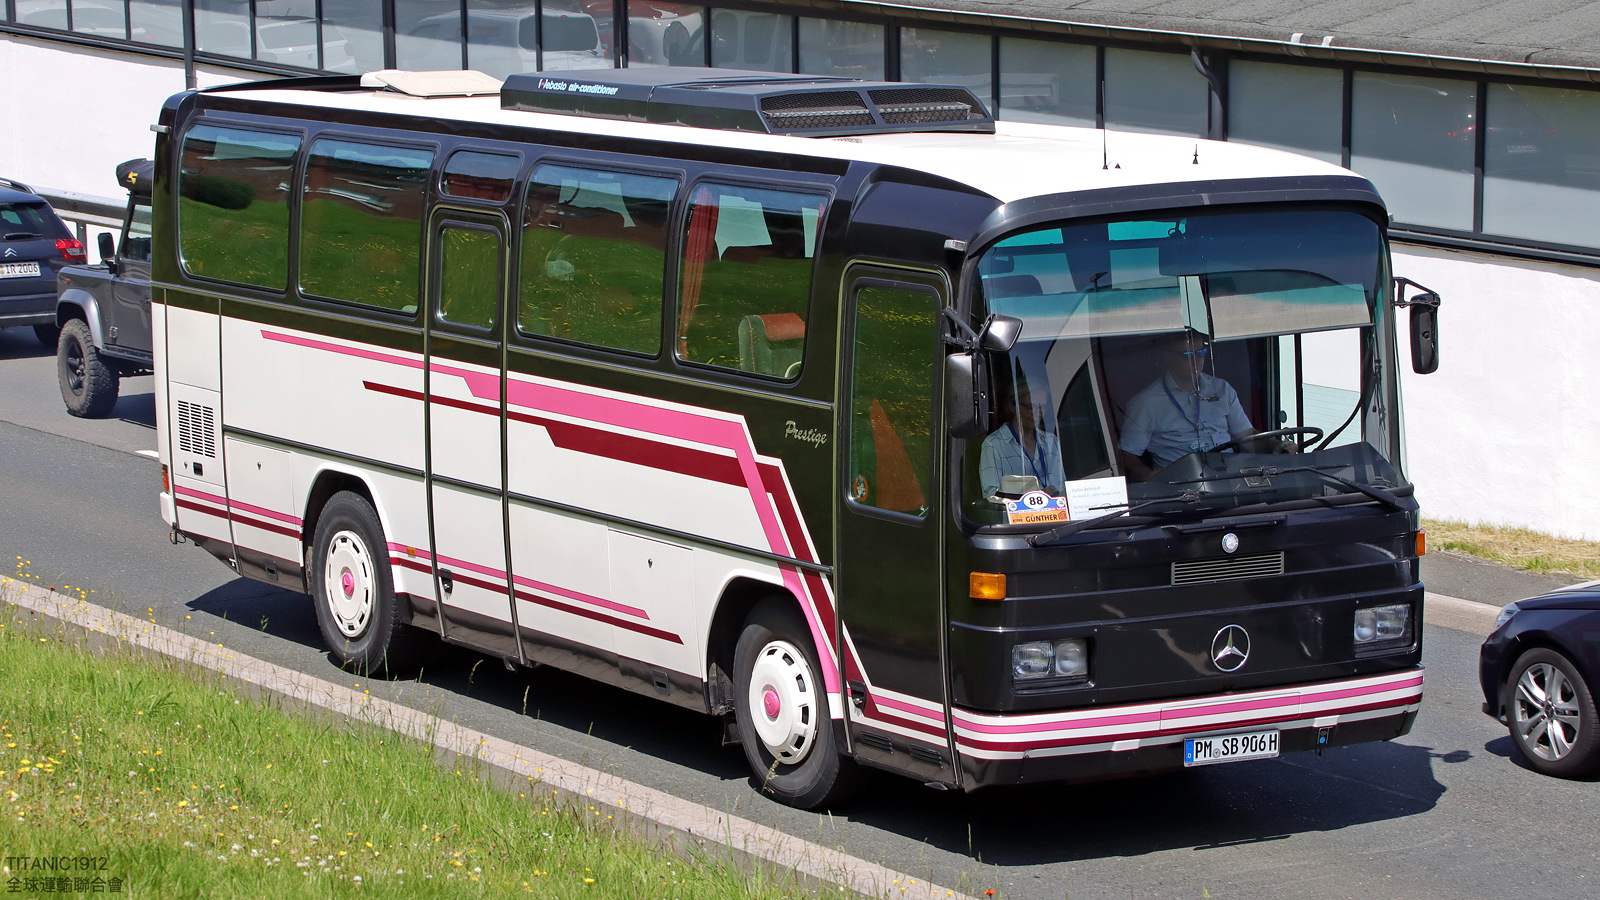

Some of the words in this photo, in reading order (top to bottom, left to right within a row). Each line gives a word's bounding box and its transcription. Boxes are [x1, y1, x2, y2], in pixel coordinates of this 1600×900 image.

[568, 82, 619, 96] air-conditioner
[18, 263, 39, 274] 2006
[785, 420, 828, 449] Prestige
[1029, 496, 1044, 506] 88
[1025, 514, 1058, 523] GÜNTHER
[1195, 740, 1212, 759] PM
[1222, 737, 1239, 756] SB
